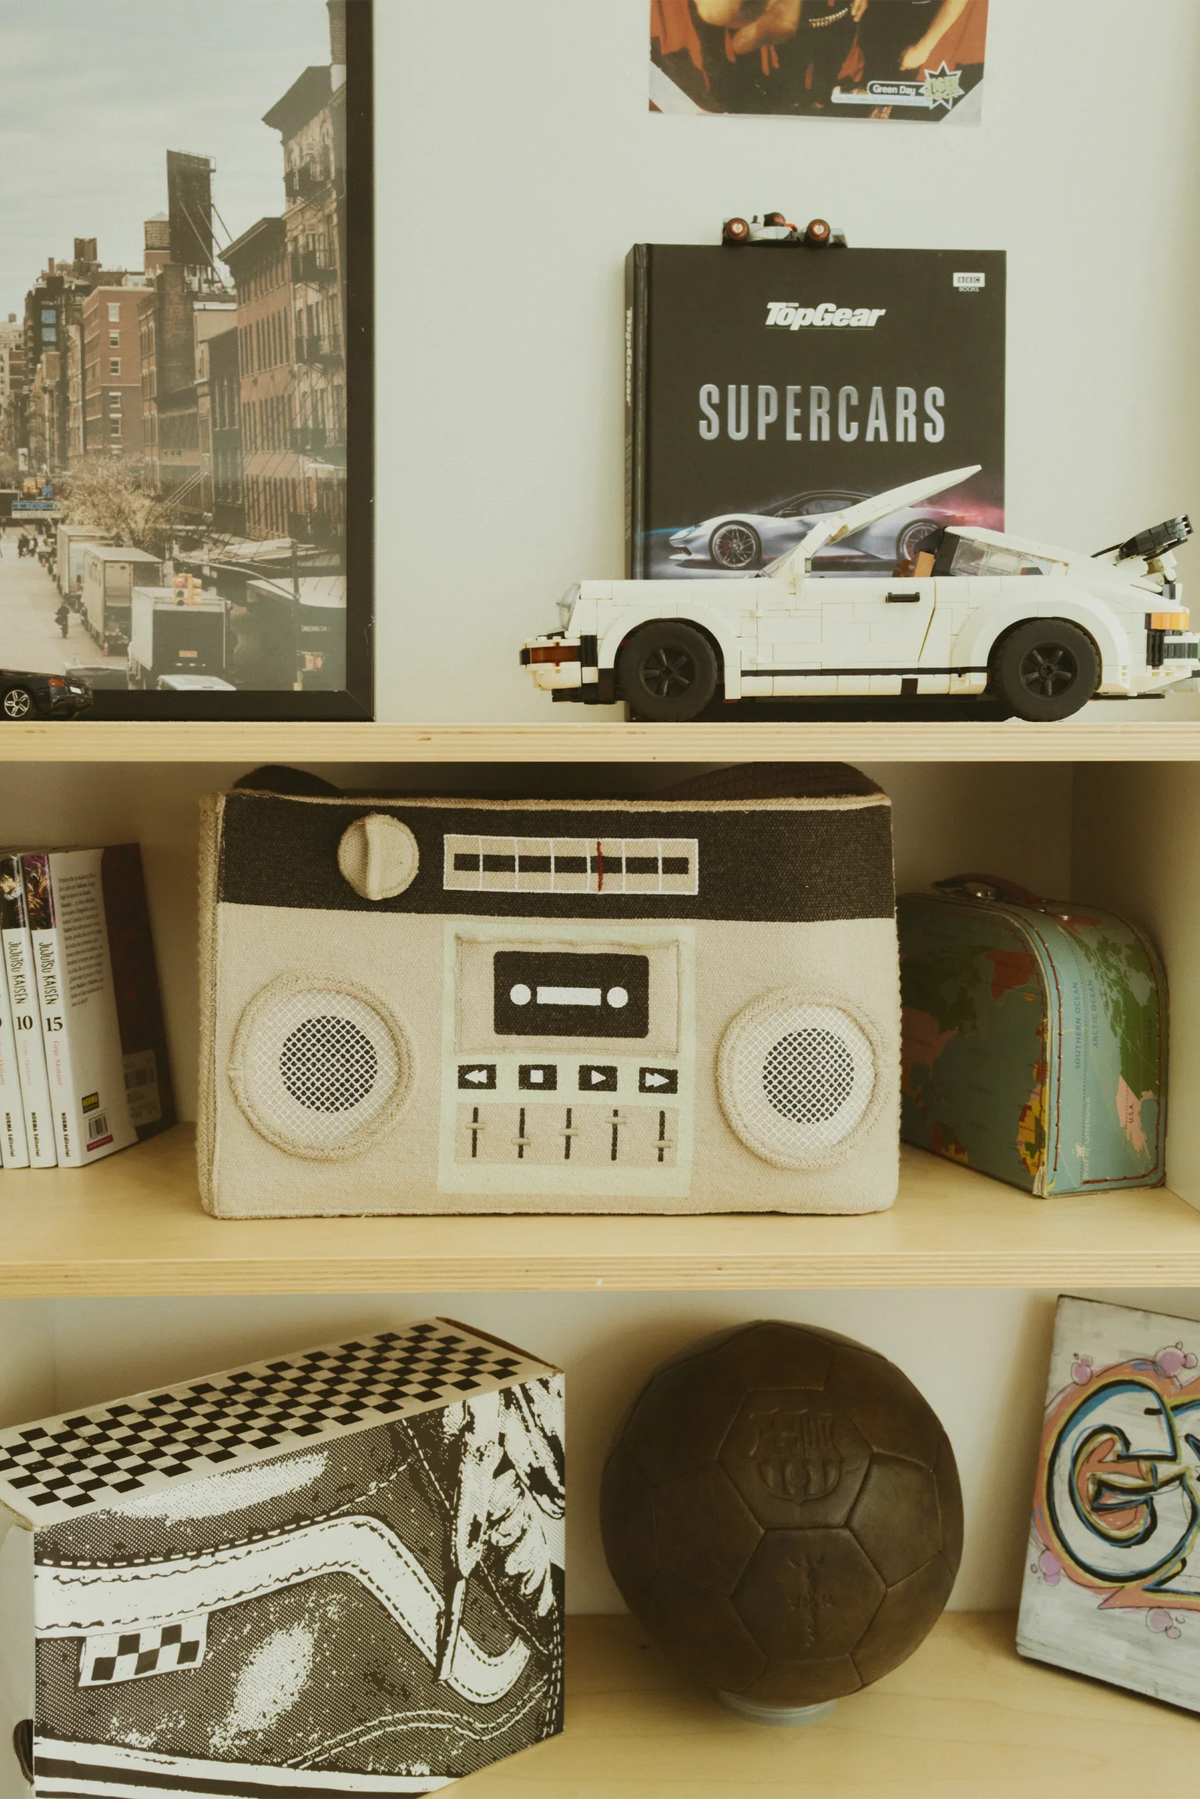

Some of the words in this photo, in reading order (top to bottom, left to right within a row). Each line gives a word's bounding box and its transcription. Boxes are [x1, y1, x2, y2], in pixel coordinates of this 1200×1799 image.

[873, 84, 898, 94] Green
[899, 86, 917, 96] Day
[765, 302, 887, 331] TopGear
[698, 384, 945, 443] SUPERCARS
[8, 941, 23, 973] JUJUTSU
[39, 942, 54, 973] JUJUTSU
[11, 974, 28, 1005] KAISEN
[42, 974, 59, 1005] KAISEN
[1073, 981, 1081, 1014] OCEAN
[1087, 979, 1097, 1011] OCEAN
[16, 1015, 33, 1031] 10
[46, 1016, 63, 1032] 15
[1091, 1012, 1099, 1050] ARCTIC
[1074, 1018, 1082, 1069] SOUTHERN
[54, 1058, 63, 1086] Akutami
[30, 1112, 38, 1132] NORMA
[60, 1112, 68, 1132] NORMA
[33, 1133, 41, 1157] Editorial
[63, 1133, 71, 1157] Editorial
[1082, 1156, 1090, 1180] West
